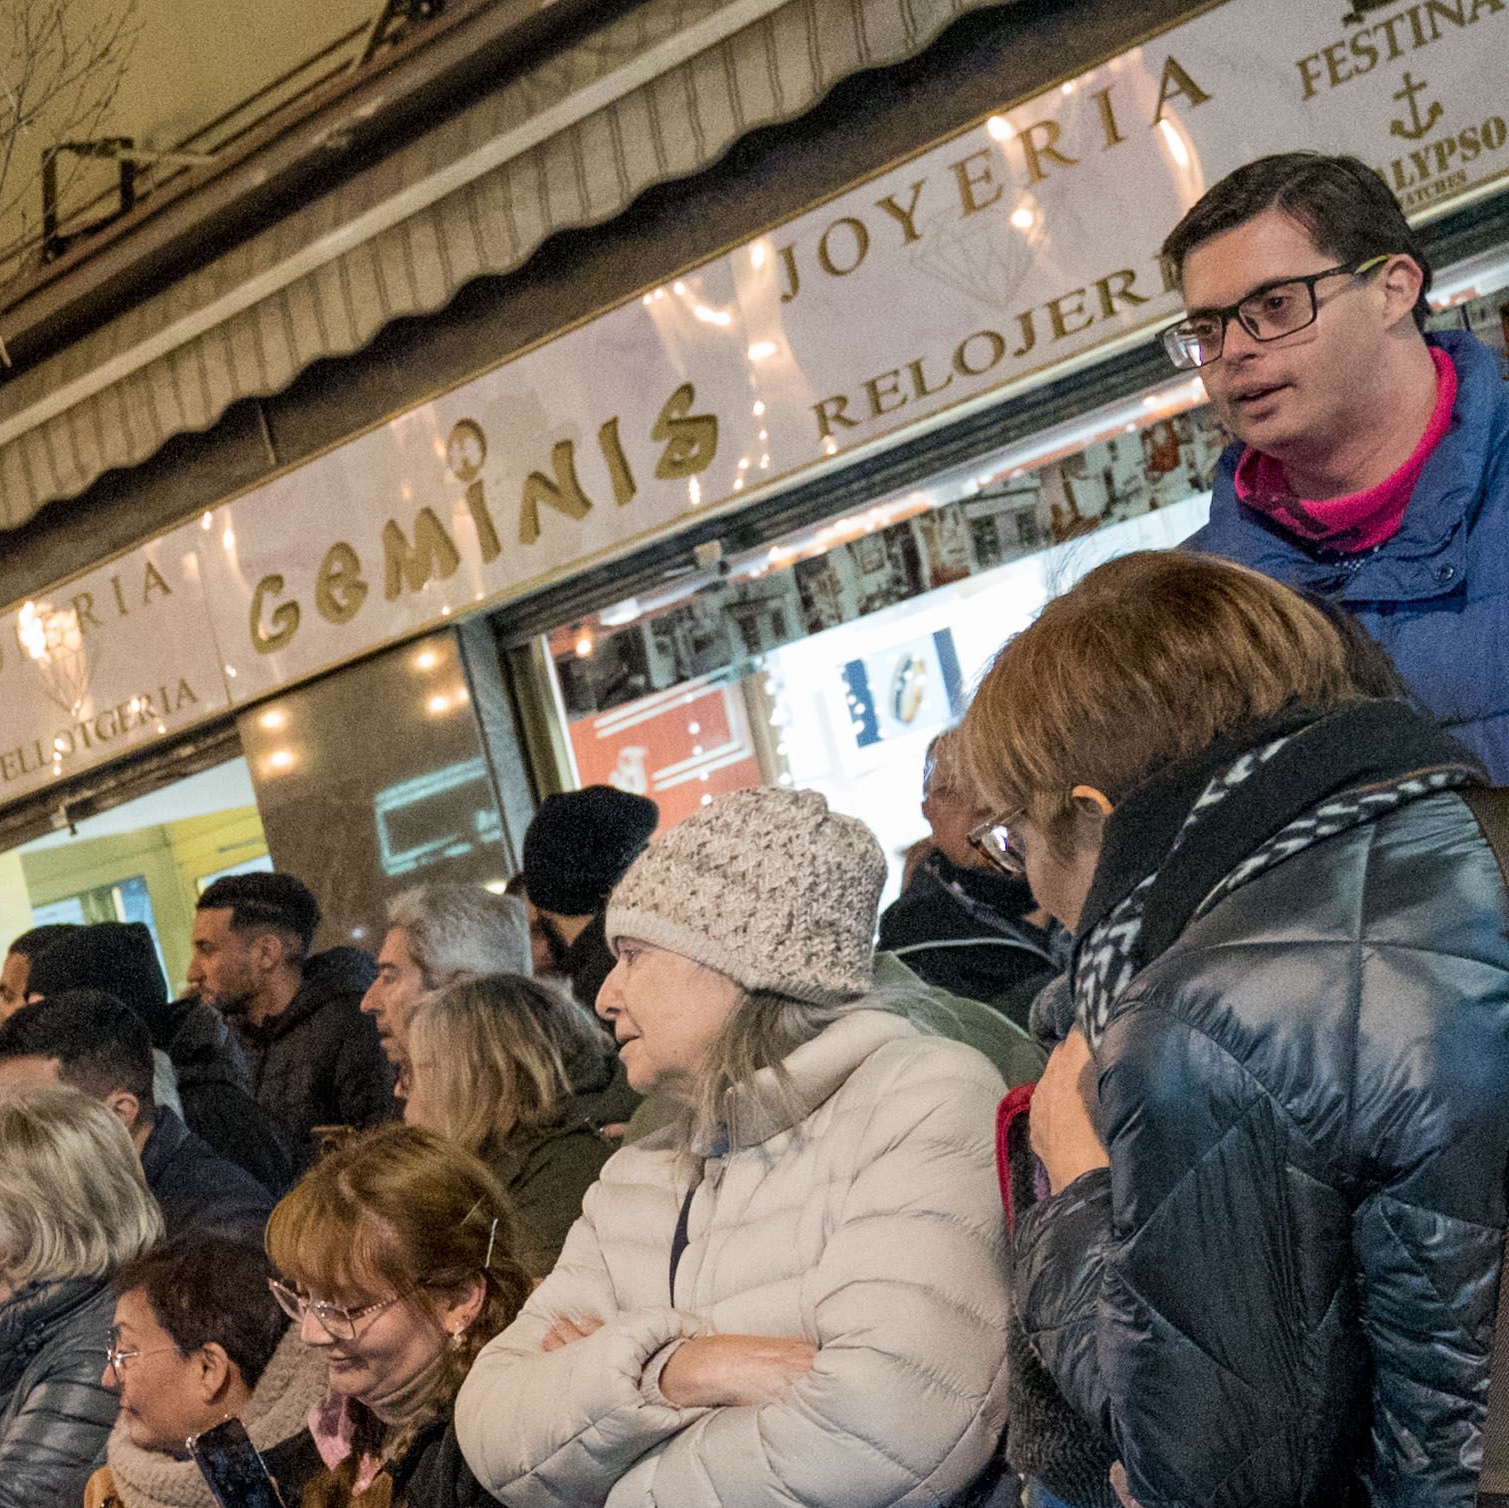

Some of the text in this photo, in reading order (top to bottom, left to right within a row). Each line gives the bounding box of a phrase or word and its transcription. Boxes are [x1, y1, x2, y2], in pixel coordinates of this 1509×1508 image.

[776, 53, 1213, 304] JOYERIA
[1373, 116, 1507, 193] LYPSO
[811, 250, 1184, 440] RELOJERI
